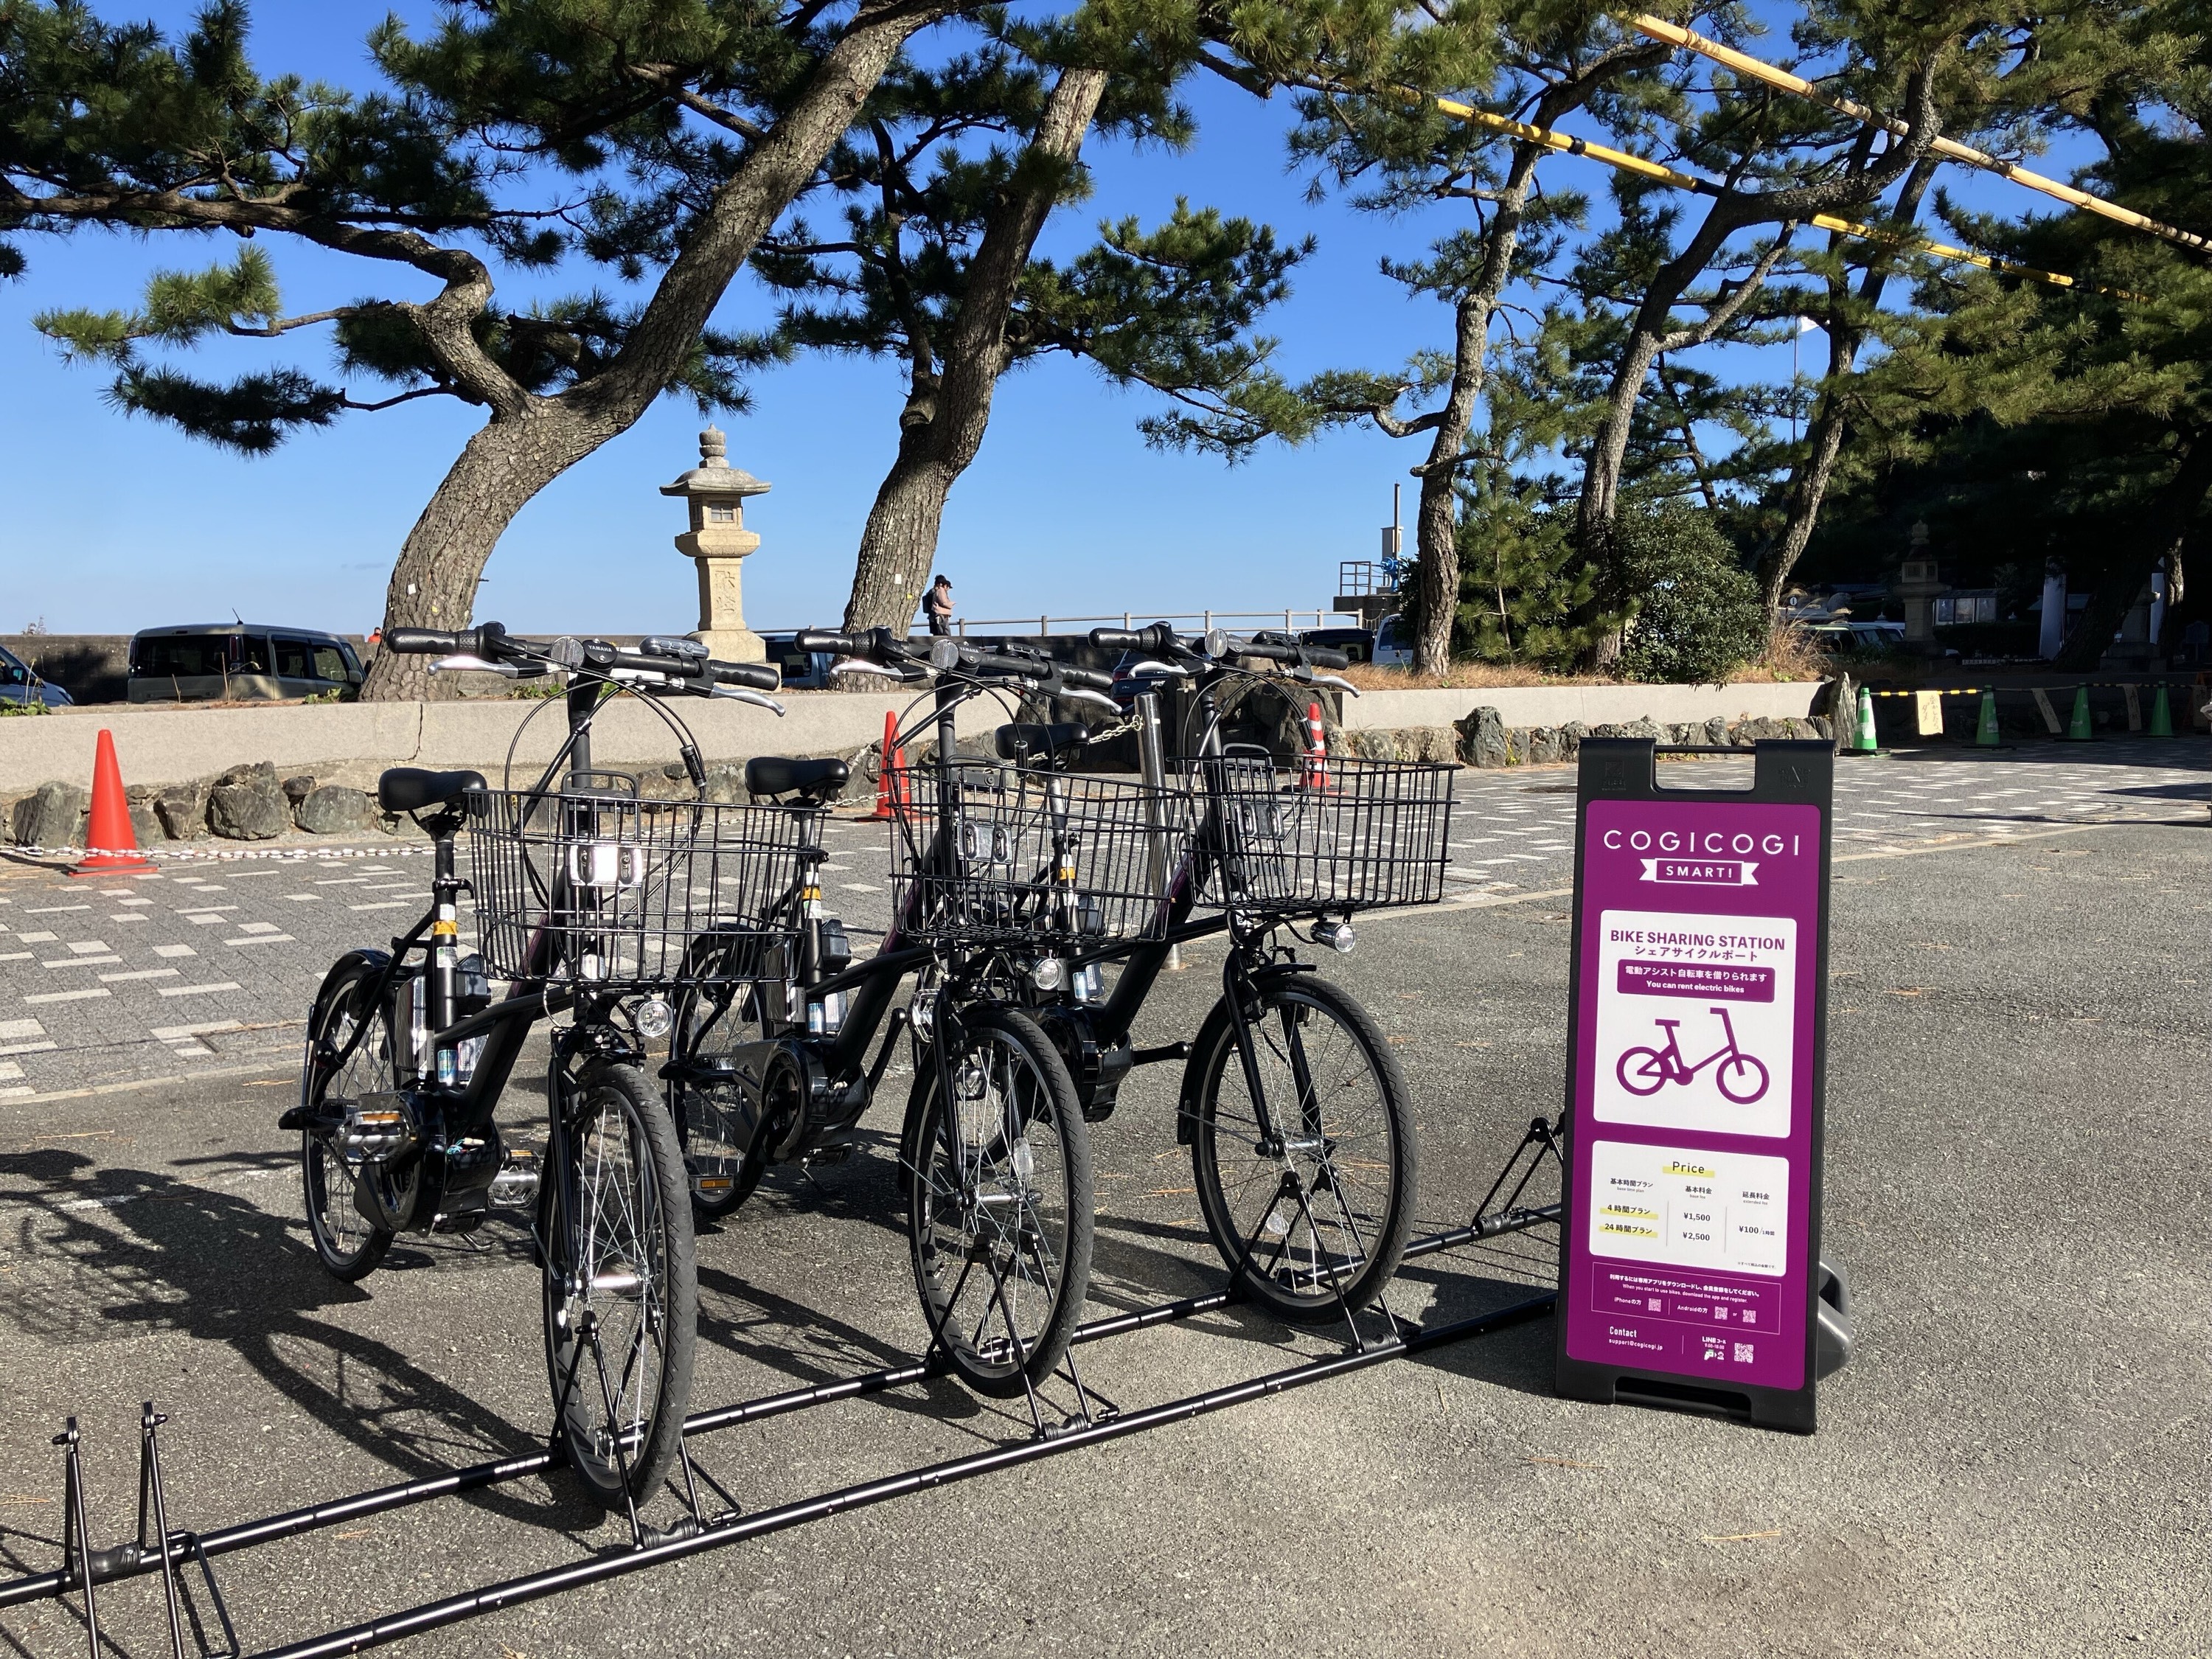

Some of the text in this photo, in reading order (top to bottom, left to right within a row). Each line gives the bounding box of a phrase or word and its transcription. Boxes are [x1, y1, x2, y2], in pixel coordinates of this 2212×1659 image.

[588, 644, 613, 653] YAMAHA
[1604, 830, 1799, 856] COGICOGI
[1666, 866, 1732, 878] SMART!
[1610, 930, 1785, 950] BIKE SHARING STATION
[1635, 945, 1758, 962] シェアサイクルポート
[1625, 965, 1767, 982] 電動アシスト自転車を借りられます
[1646, 980, 1661, 988] You
[1694, 984, 1722, 992] electric
[1724, 985, 1745, 993] bikes
[1672, 1161, 1705, 1174] Price
[1610, 1178, 1653, 1188] 基本時間プラン
[1686, 1186, 1712, 1194] 基本料金
[1742, 1191, 1770, 1200] 延長料金
[1683, 1212, 1711, 1222] ¥1,500
[1683, 1232, 1710, 1241] ¥2,500
[1609, 1326, 1637, 1338] Contact
[1608, 1338, 1663, 1351] support@cogicogi.jp
